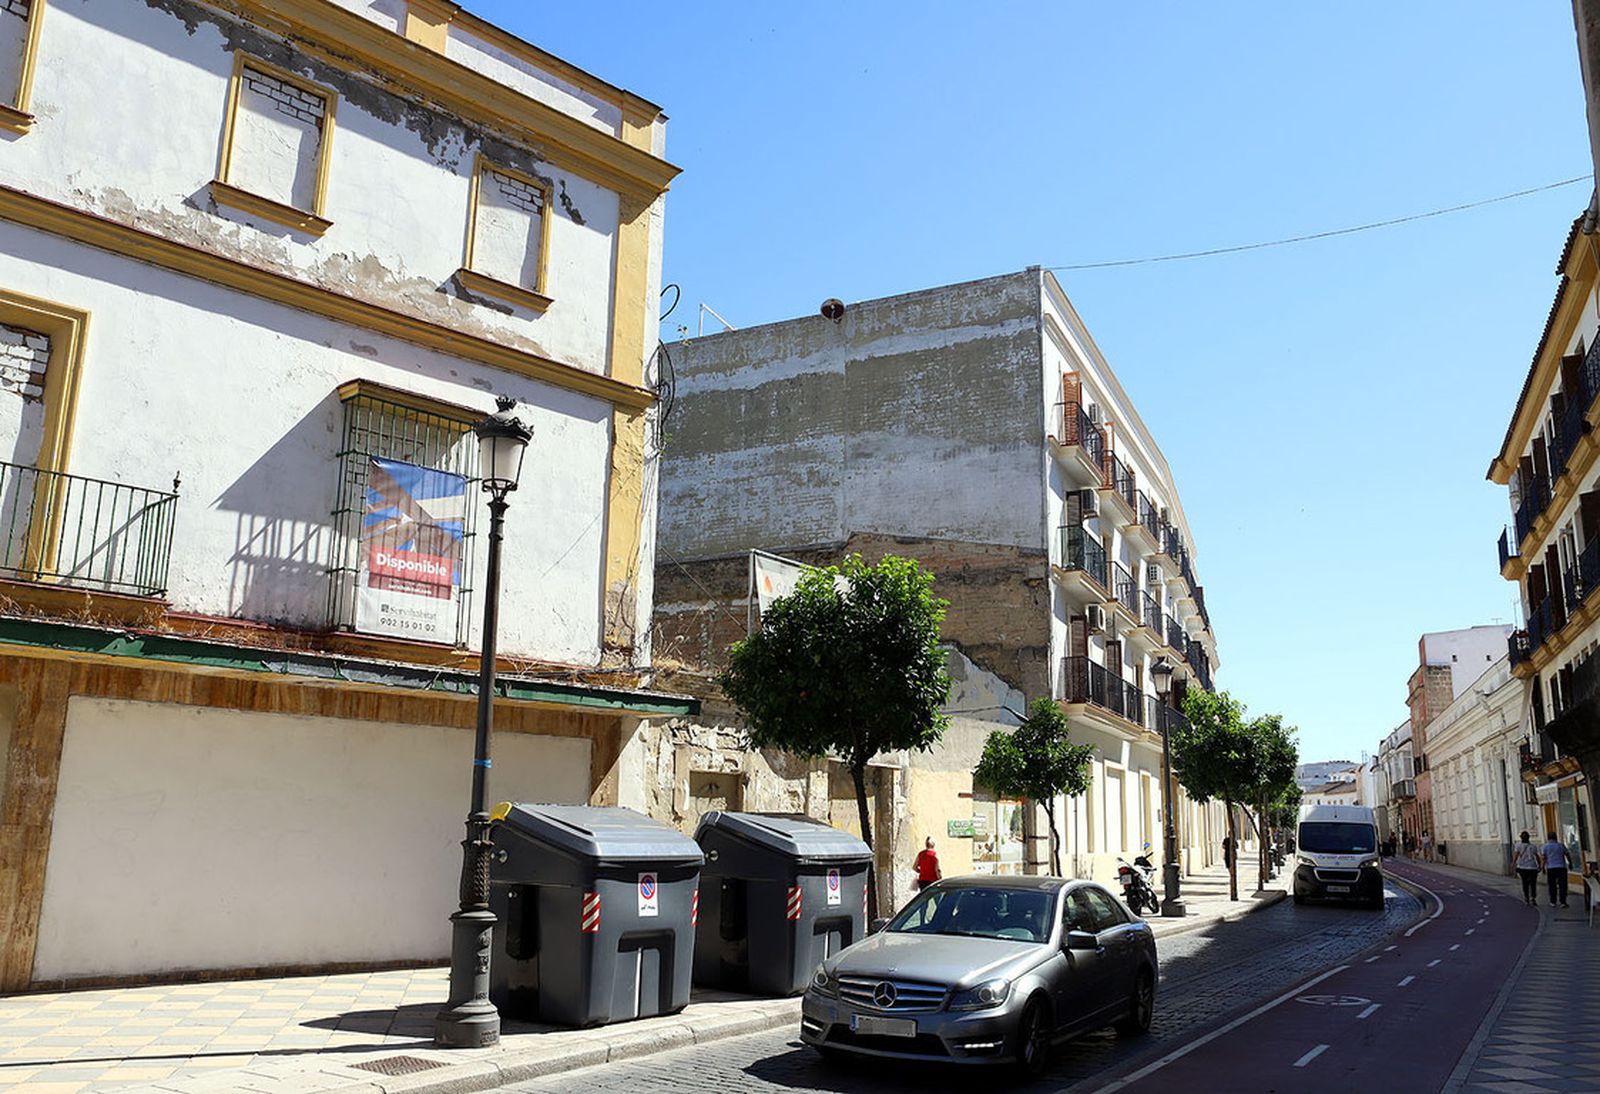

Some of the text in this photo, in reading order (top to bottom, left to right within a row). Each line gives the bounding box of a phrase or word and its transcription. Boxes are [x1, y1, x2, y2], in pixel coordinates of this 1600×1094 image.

[376, 553, 447, 577] Disponible
[380, 617, 436, 632] 902 15 01 02
